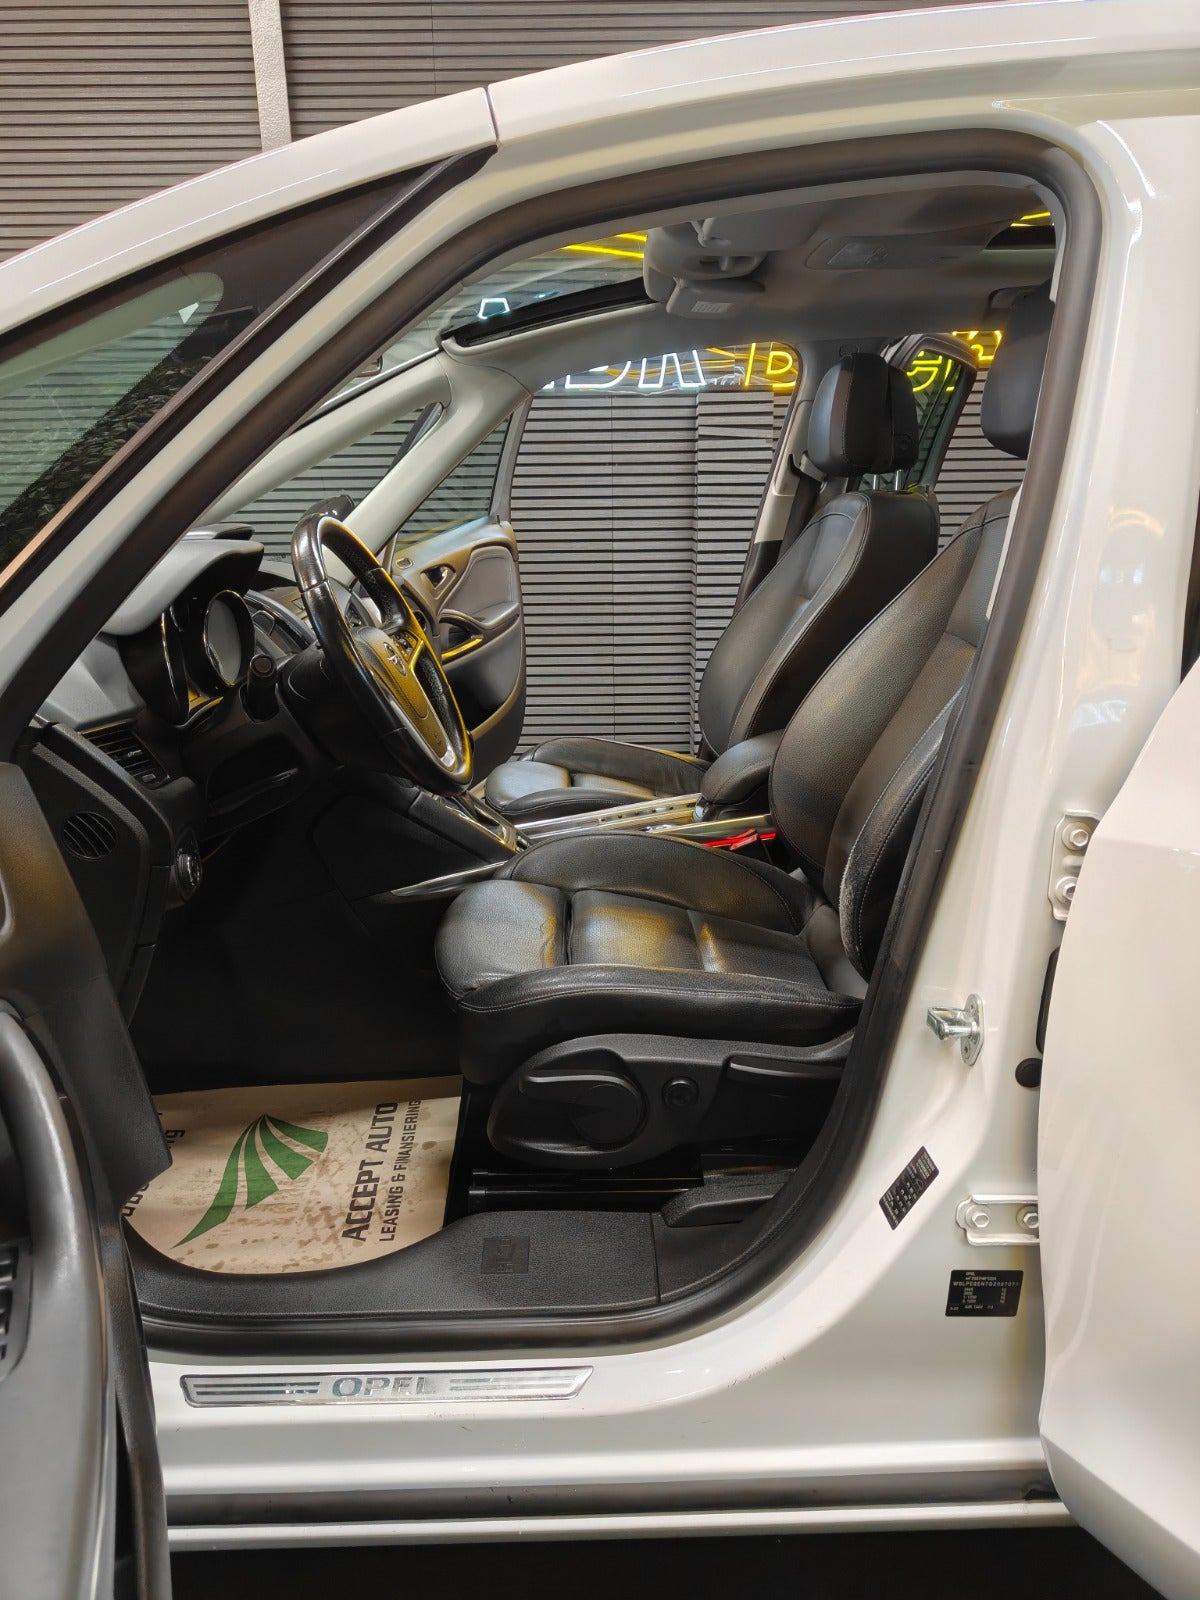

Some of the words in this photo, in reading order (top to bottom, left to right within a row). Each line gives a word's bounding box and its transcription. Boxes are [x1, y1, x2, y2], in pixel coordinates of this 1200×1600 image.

[341, 1159, 384, 1242] ACCEPT
[365, 1101, 399, 1154] AUTO
[378, 1182, 404, 1242] LEASING
[393, 1099, 422, 1174] FINANSIERING
[332, 1376, 437, 1397] OPEL
